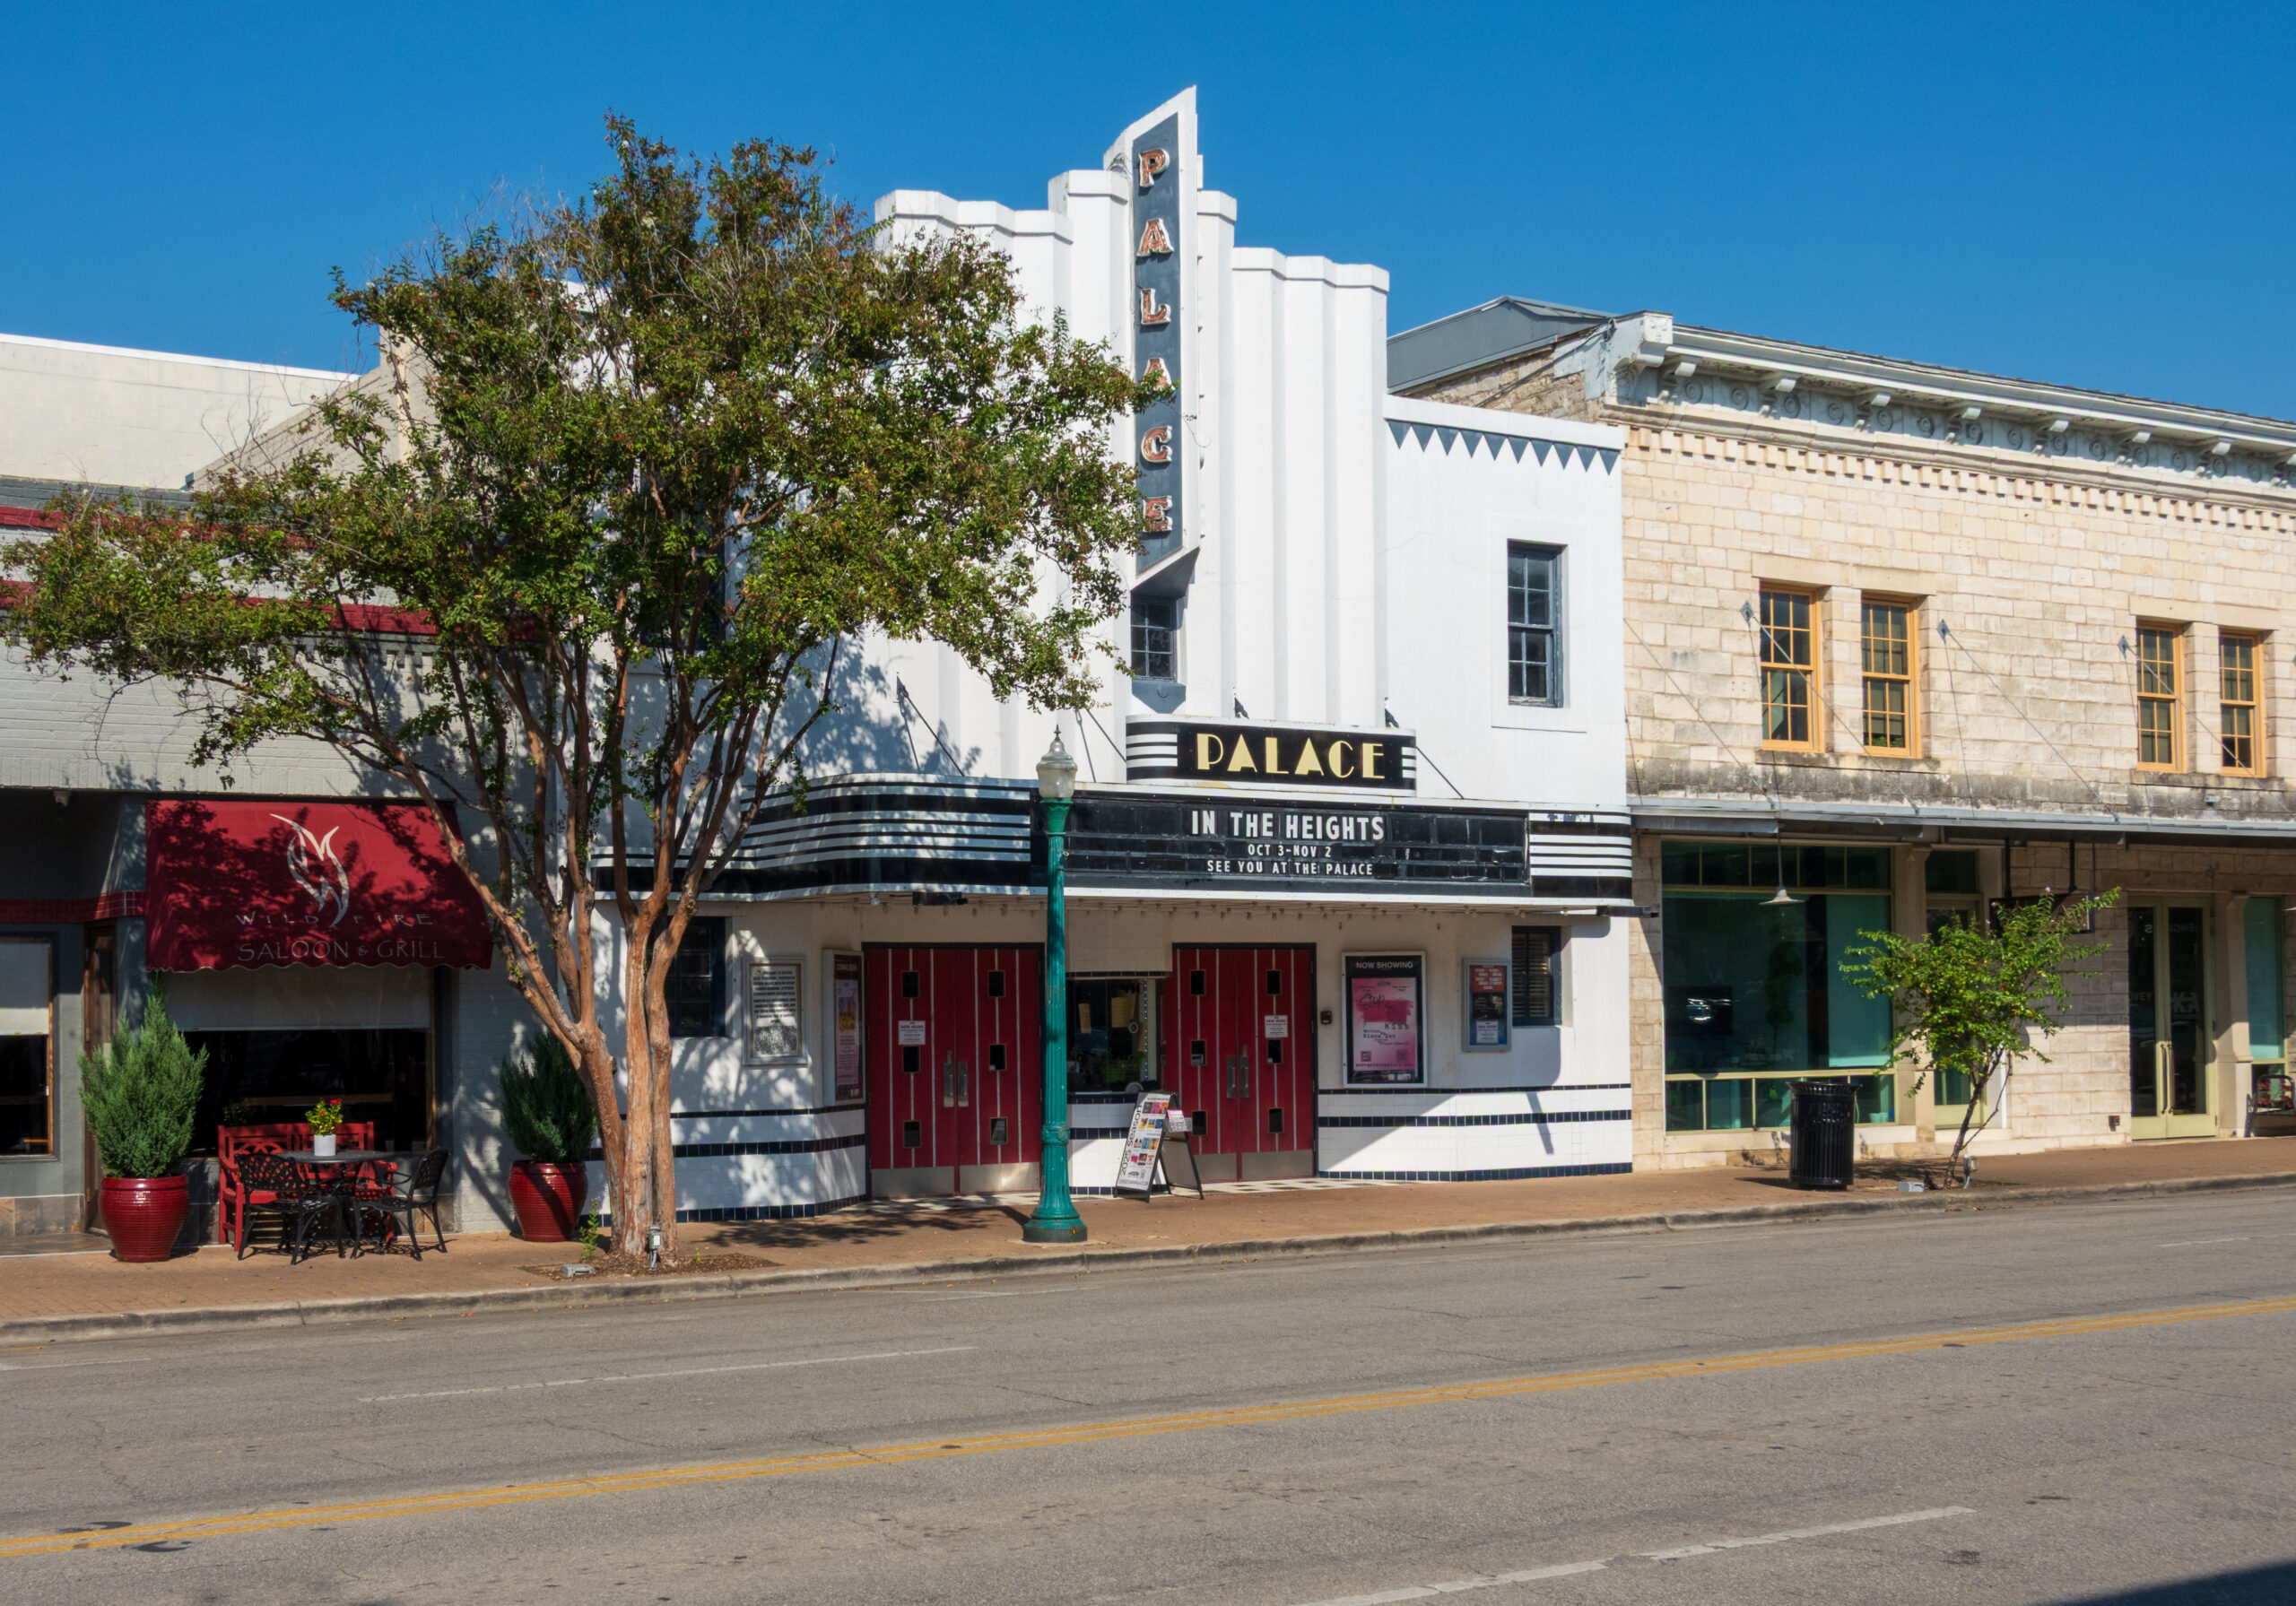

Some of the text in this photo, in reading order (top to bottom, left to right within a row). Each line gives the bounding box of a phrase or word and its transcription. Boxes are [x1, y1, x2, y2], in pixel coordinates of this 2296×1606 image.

[1136, 149, 1175, 533] PALACE
[1196, 733, 1386, 779] PALACE
[1191, 810, 1385, 841] IN THE HEIGHTS
[1248, 844, 1332, 857] OCT 3-NOV 2
[1207, 860, 1373, 875] SEE YOU AT THE PALACE
[235, 910, 433, 927] WILD FIRE
[237, 940, 445, 961] SALOON & GRILL
[1119, 1150, 1132, 1176] 2025
